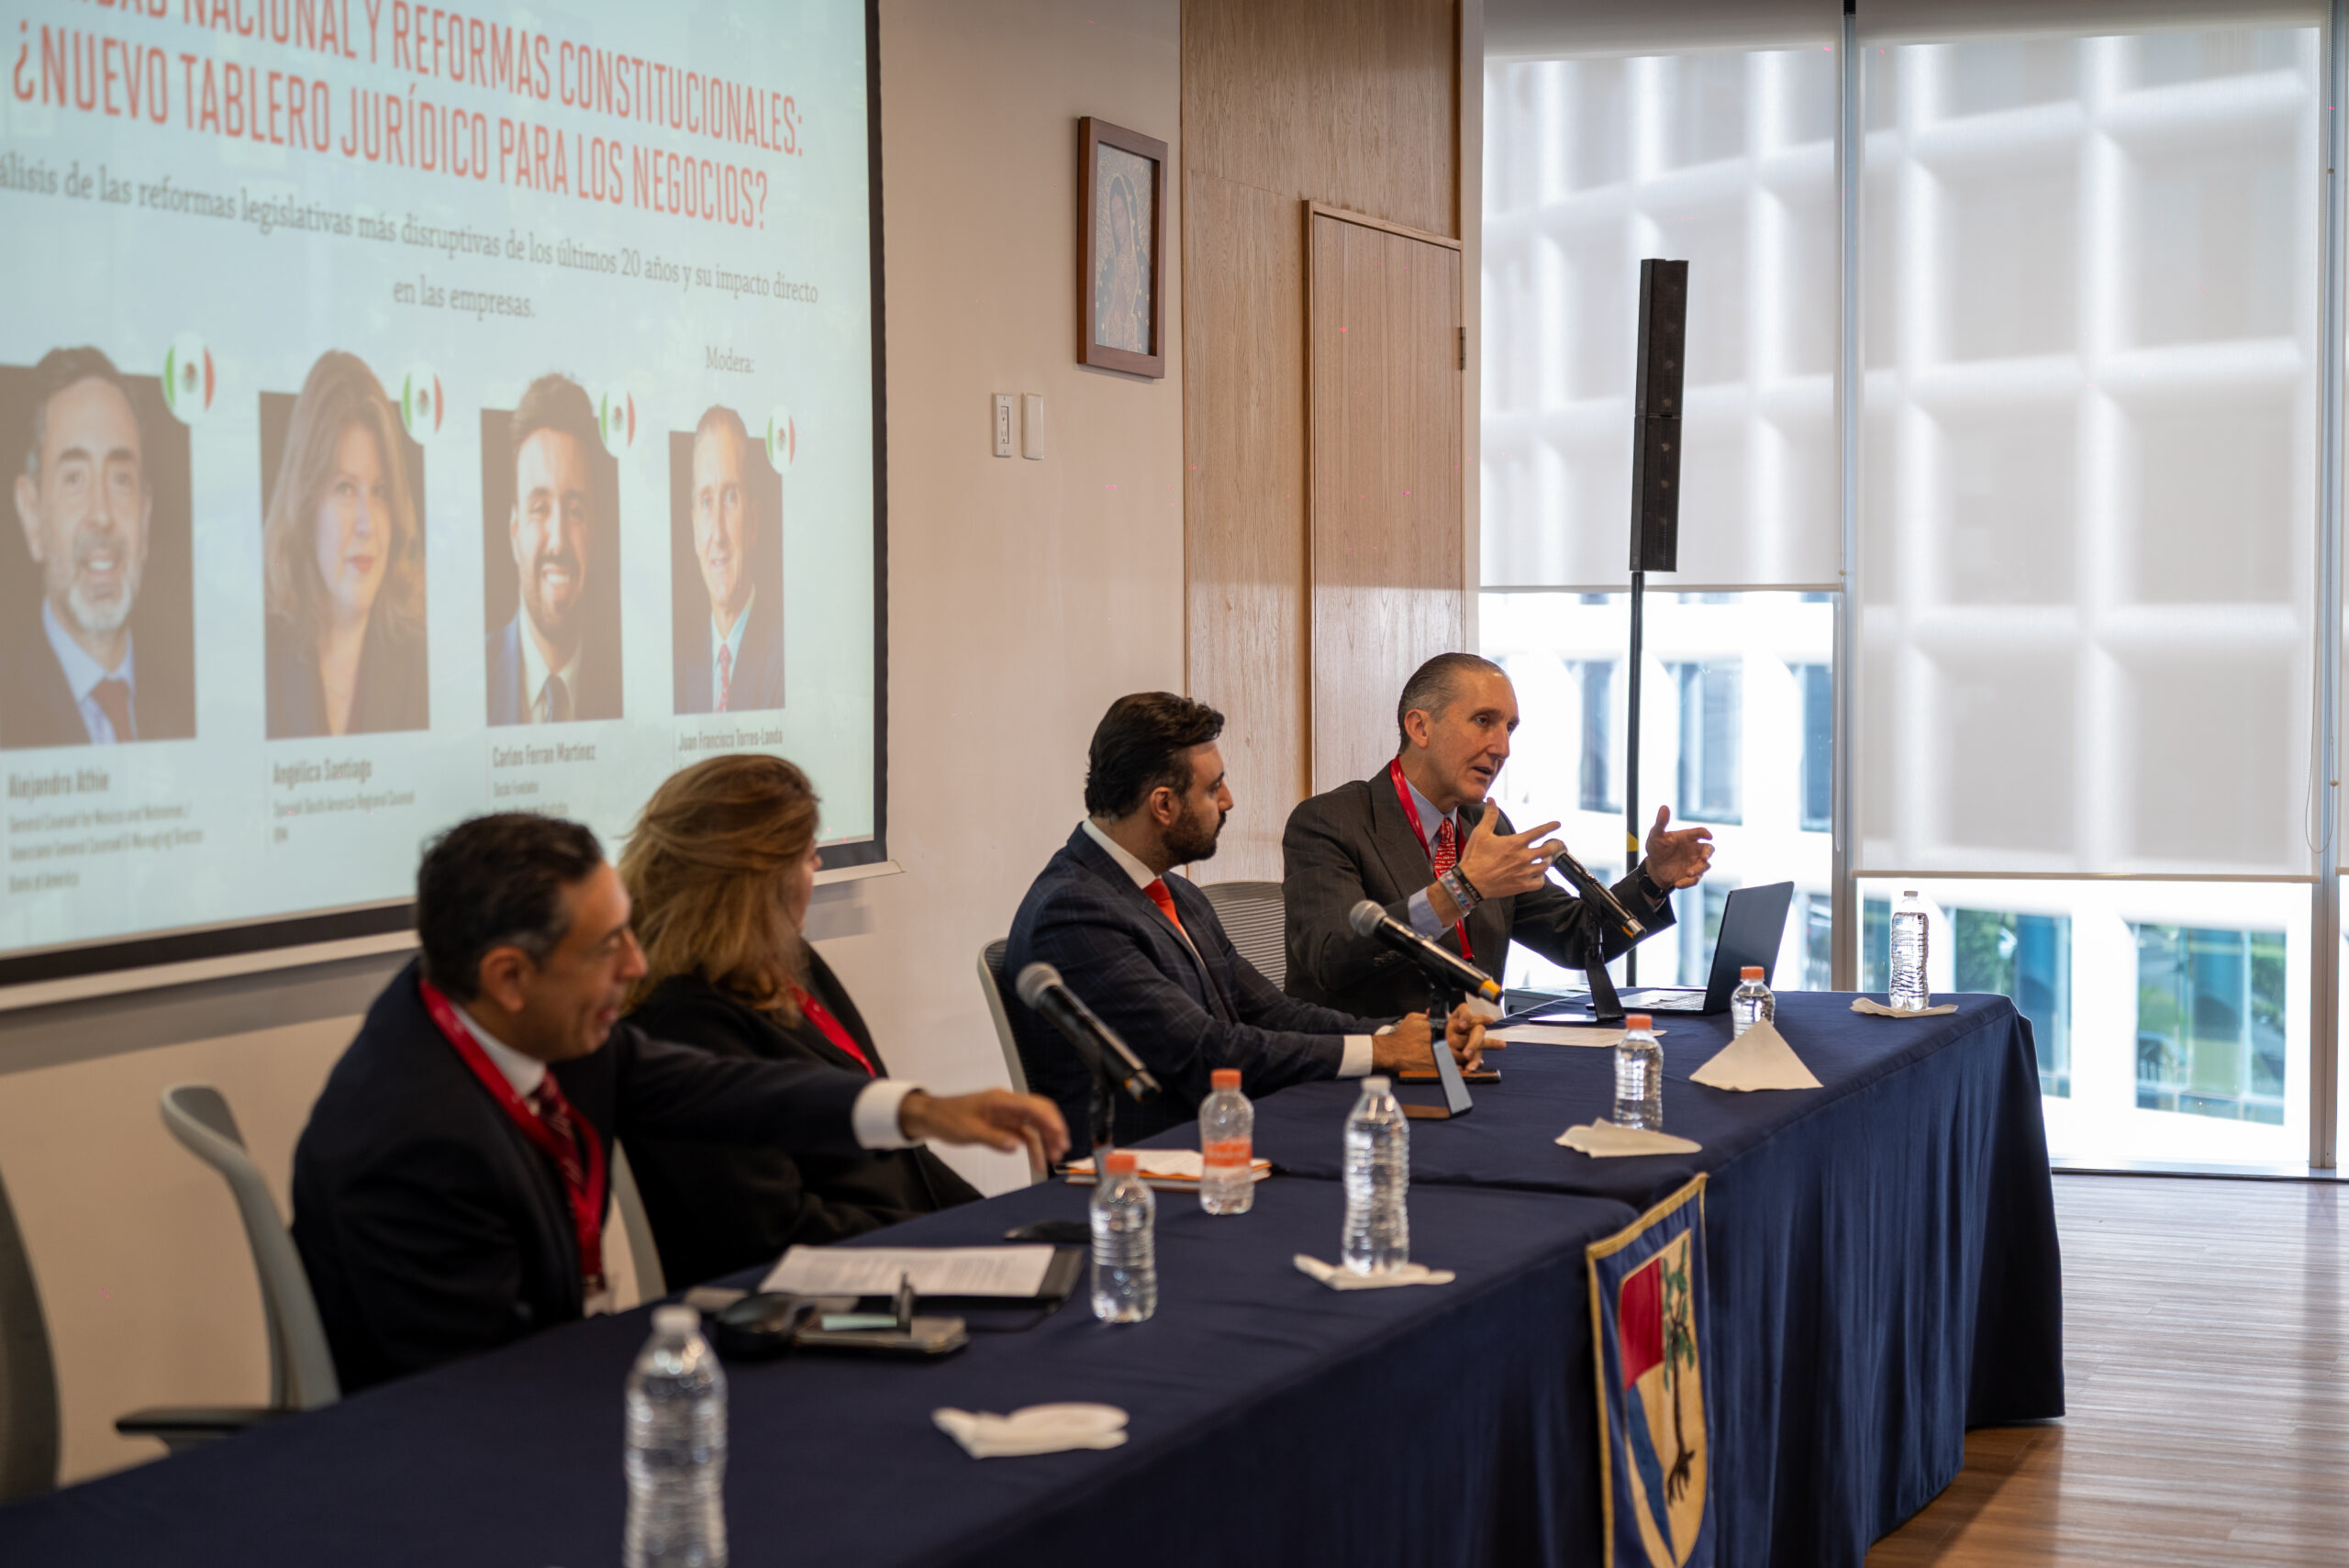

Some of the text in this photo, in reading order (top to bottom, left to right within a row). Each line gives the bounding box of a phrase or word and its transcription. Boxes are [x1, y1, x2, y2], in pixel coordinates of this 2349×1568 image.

[364, 0, 382, 64] Y
[393, 1, 551, 101] REFORMAS
[560, 40, 803, 157] CONSTITUCIONALES:
[13, 19, 768, 230] ¿NUEVO TABLERO JURÍDICO PARA LOS NEGOCIOS?
[63, 160, 94, 200] de
[98, 163, 132, 205] las
[139, 175, 237, 219] reformas
[240, 186, 353, 236] legislativas
[357, 212, 396, 242] más
[401, 211, 501, 260] disruptivas
[505, 228, 525, 261] de
[529, 231, 553, 264] los
[556, 237, 618, 274] últimos
[620, 247, 641, 277] 20
[644, 255, 680, 284] años
[682, 264, 693, 293] y
[696, 266, 713, 288] su
[715, 263, 771, 300] impacto
[773, 271, 819, 304] directo
[393, 273, 536, 322] en las empresas.
[705, 345, 755, 374] Modera:
[493, 745, 524, 768] Carlos
[678, 731, 698, 751] Juan
[699, 729, 735, 750] Francisco
[8, 771, 73, 805] Alejandro
